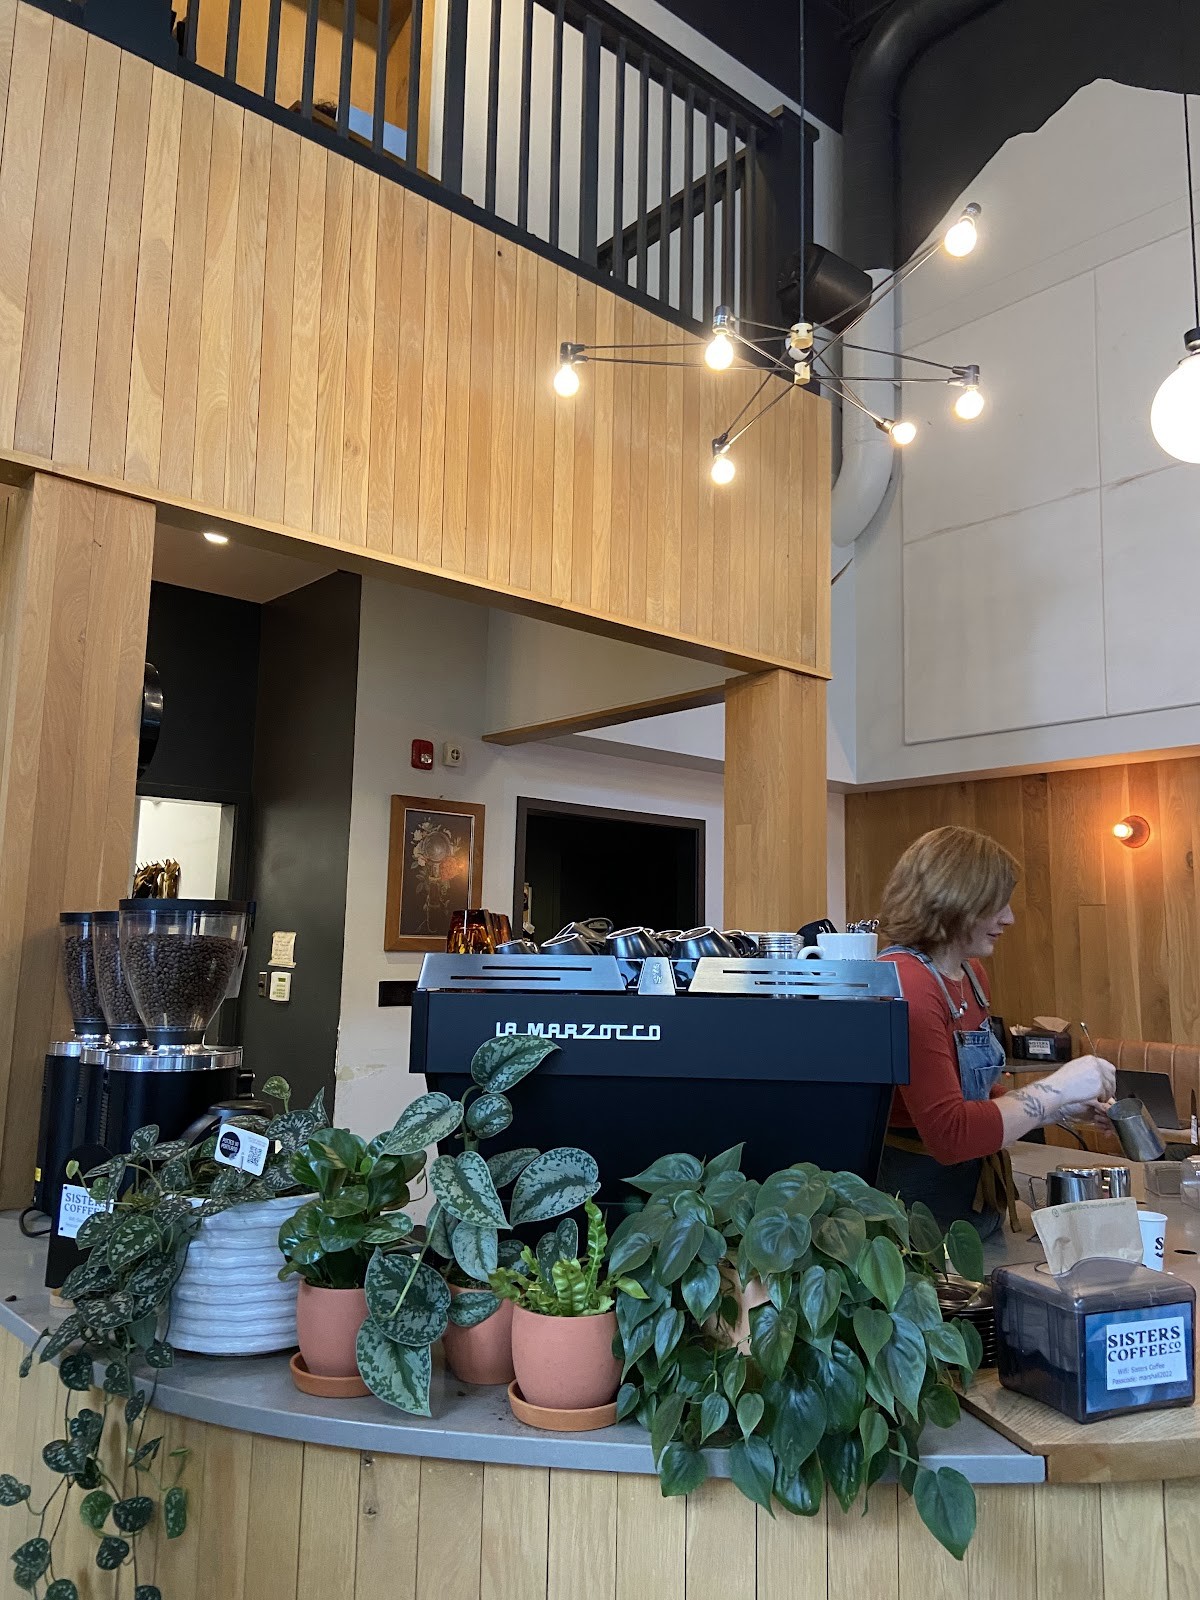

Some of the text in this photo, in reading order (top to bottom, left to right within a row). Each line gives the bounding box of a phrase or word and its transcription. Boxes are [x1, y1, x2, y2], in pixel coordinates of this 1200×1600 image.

[496, 1022, 661, 1041] LA MARZOCCO
[1108, 1325, 1180, 1348] SISTERS
[1107, 1343, 1167, 1362] COFFEE
